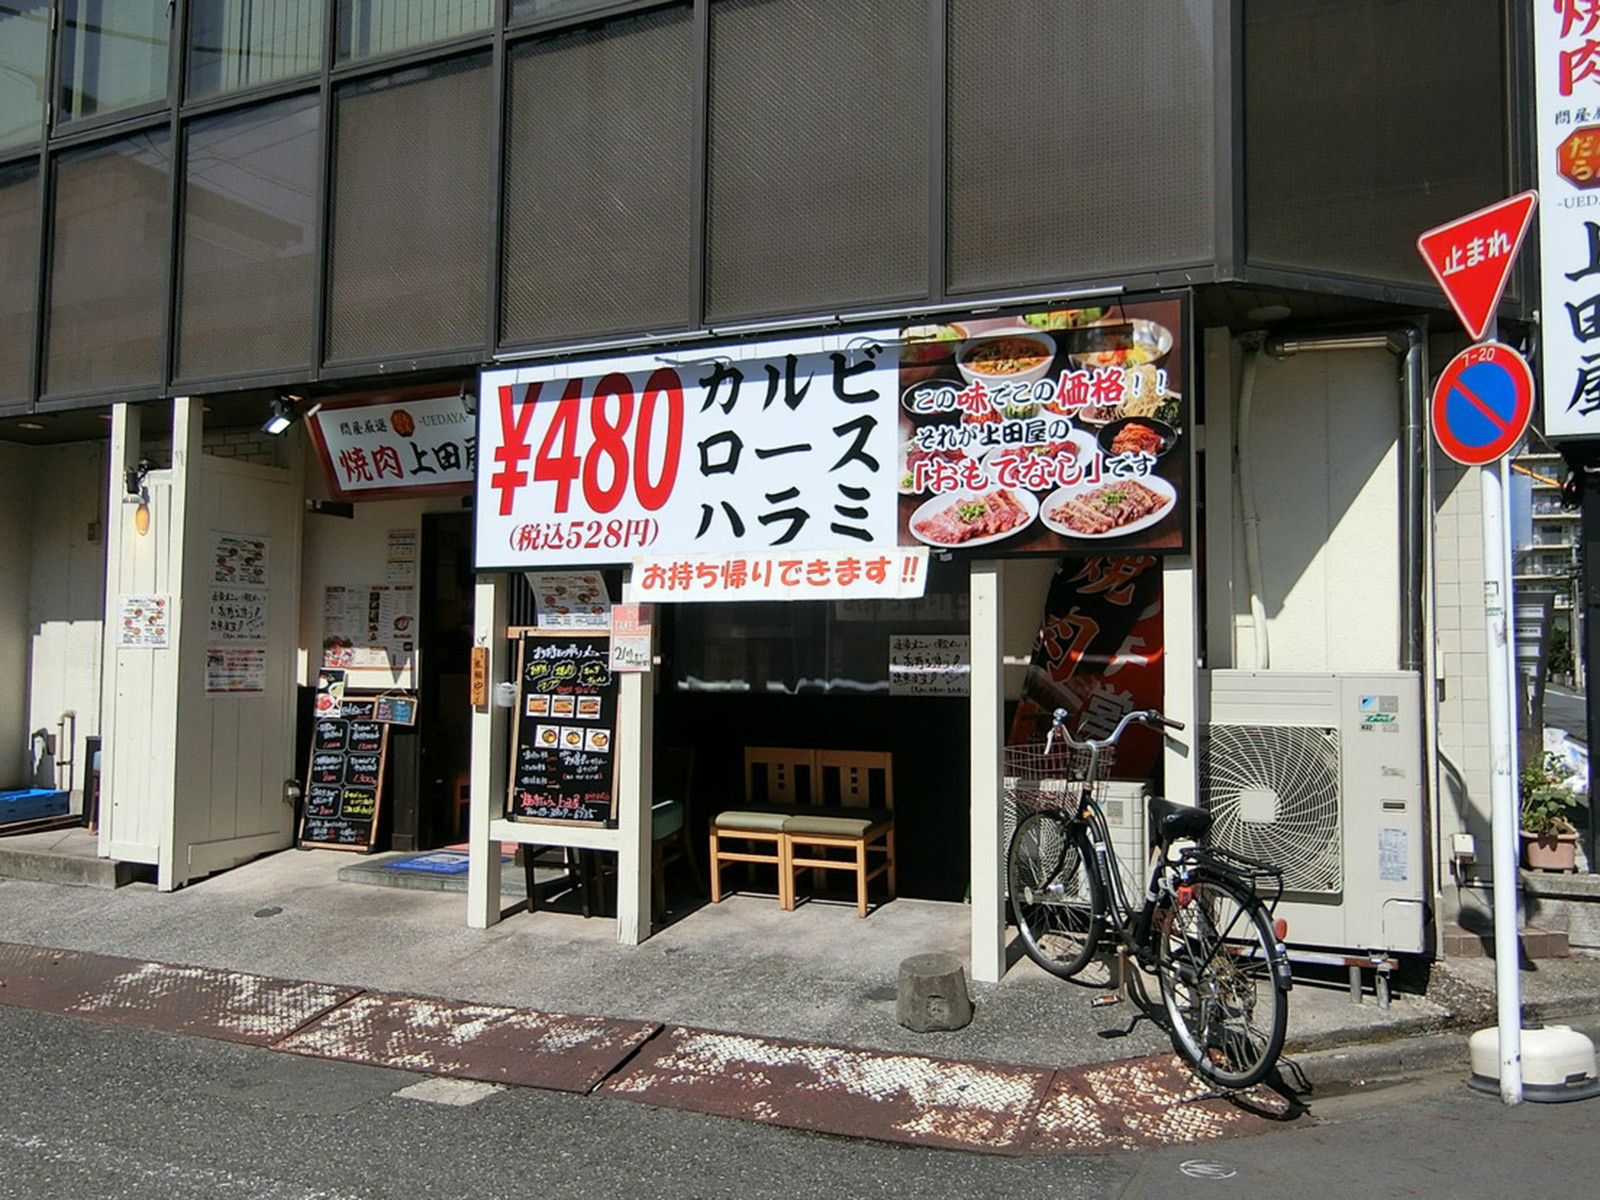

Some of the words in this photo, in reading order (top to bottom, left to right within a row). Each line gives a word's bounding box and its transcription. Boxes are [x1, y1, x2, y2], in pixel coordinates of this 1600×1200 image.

[1569, 136, 1600, 159] だ
[1570, 159, 1600, 181] ら
[1442, 228, 1511, 276] 止まれ
[1461, 347, 1496, 367] 7-20
[698, 345, 883, 414] カルビ
[491, 366, 685, 515] ¥480
[699, 415, 880, 477] ロース
[916, 420, 1070, 449] それが上田屋の
[339, 445, 404, 482] 焼肉
[913, 453, 1155, 491] 「おもてなし」です
[695, 483, 874, 546] ハラミ
[509, 518, 660, 551] (税込528円)
